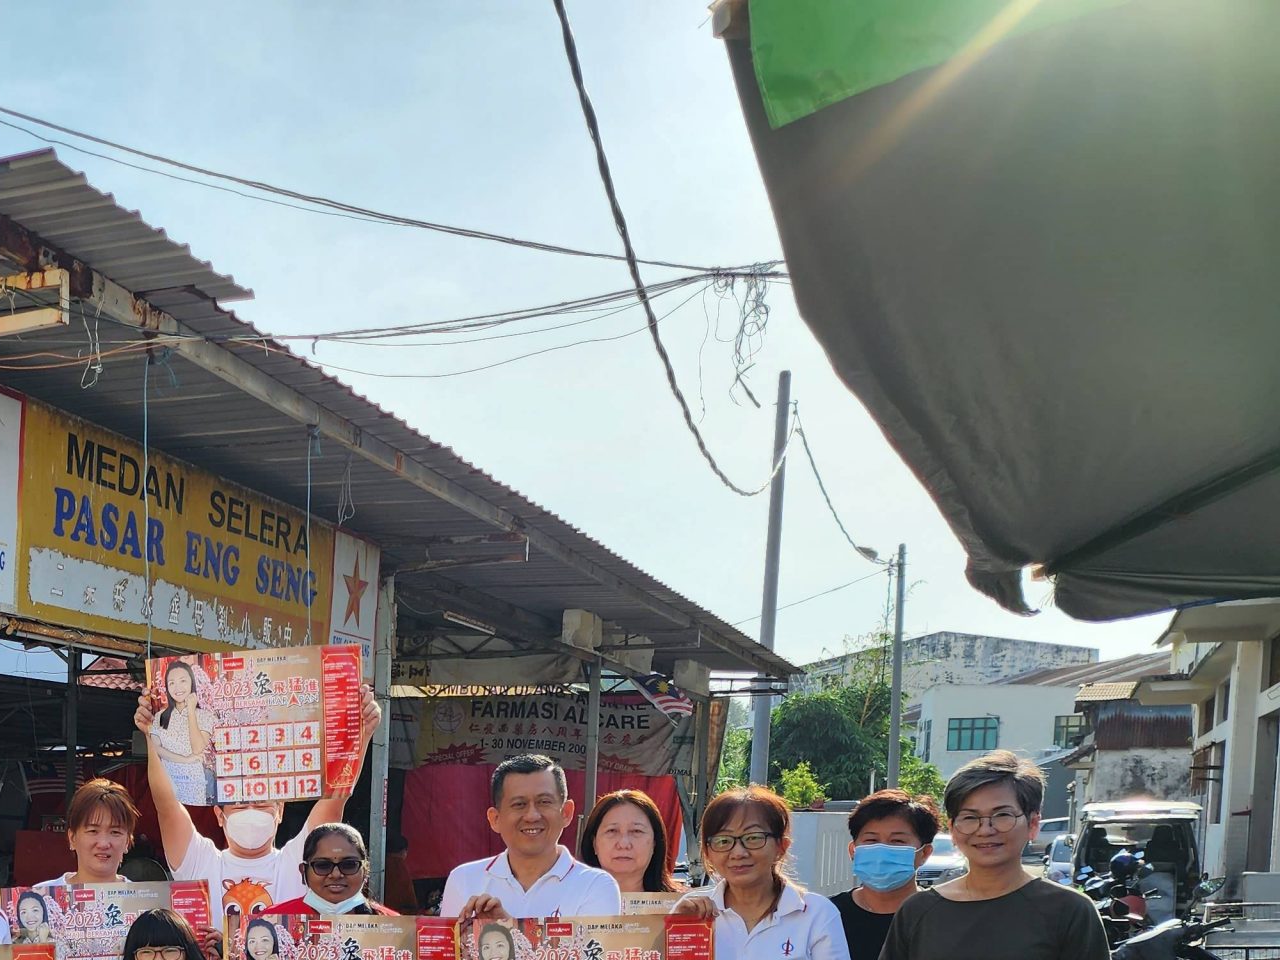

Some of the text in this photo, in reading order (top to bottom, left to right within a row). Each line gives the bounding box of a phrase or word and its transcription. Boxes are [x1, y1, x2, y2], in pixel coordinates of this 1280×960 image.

[66, 433, 311, 559] MEDAN SELERA
[54, 487, 318, 607] PASAR ENG SENG
[471, 700, 558, 720] FARMASI
[491, 739, 504, 750] 30
[506, 738, 566, 752] NOVEMBER
